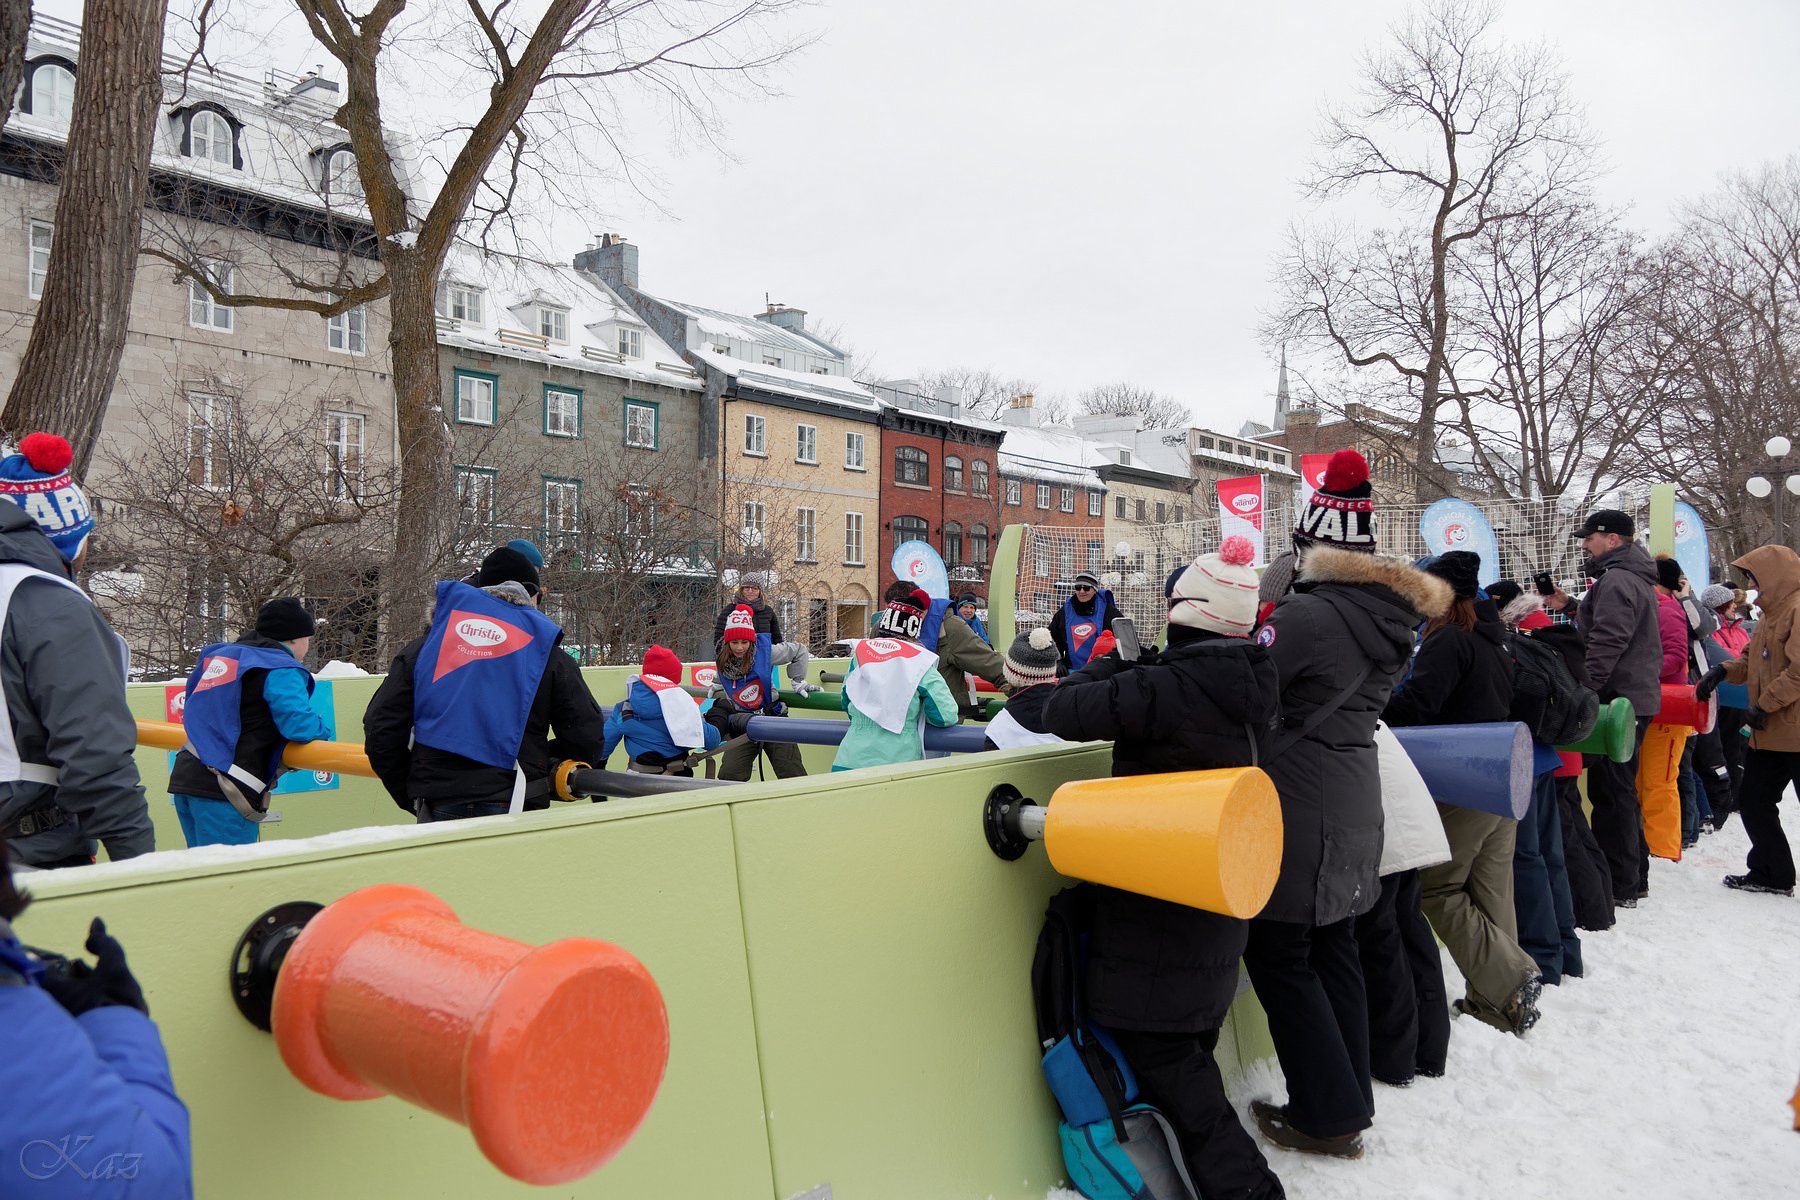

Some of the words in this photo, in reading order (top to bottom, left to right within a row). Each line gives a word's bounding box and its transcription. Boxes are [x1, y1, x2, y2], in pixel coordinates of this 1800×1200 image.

[1313, 495, 1366, 509] QUÉBEC
[460, 622, 502, 642] Christie
[457, 644, 493, 657] COLLECTION
[869, 639, 898, 650] Christie
